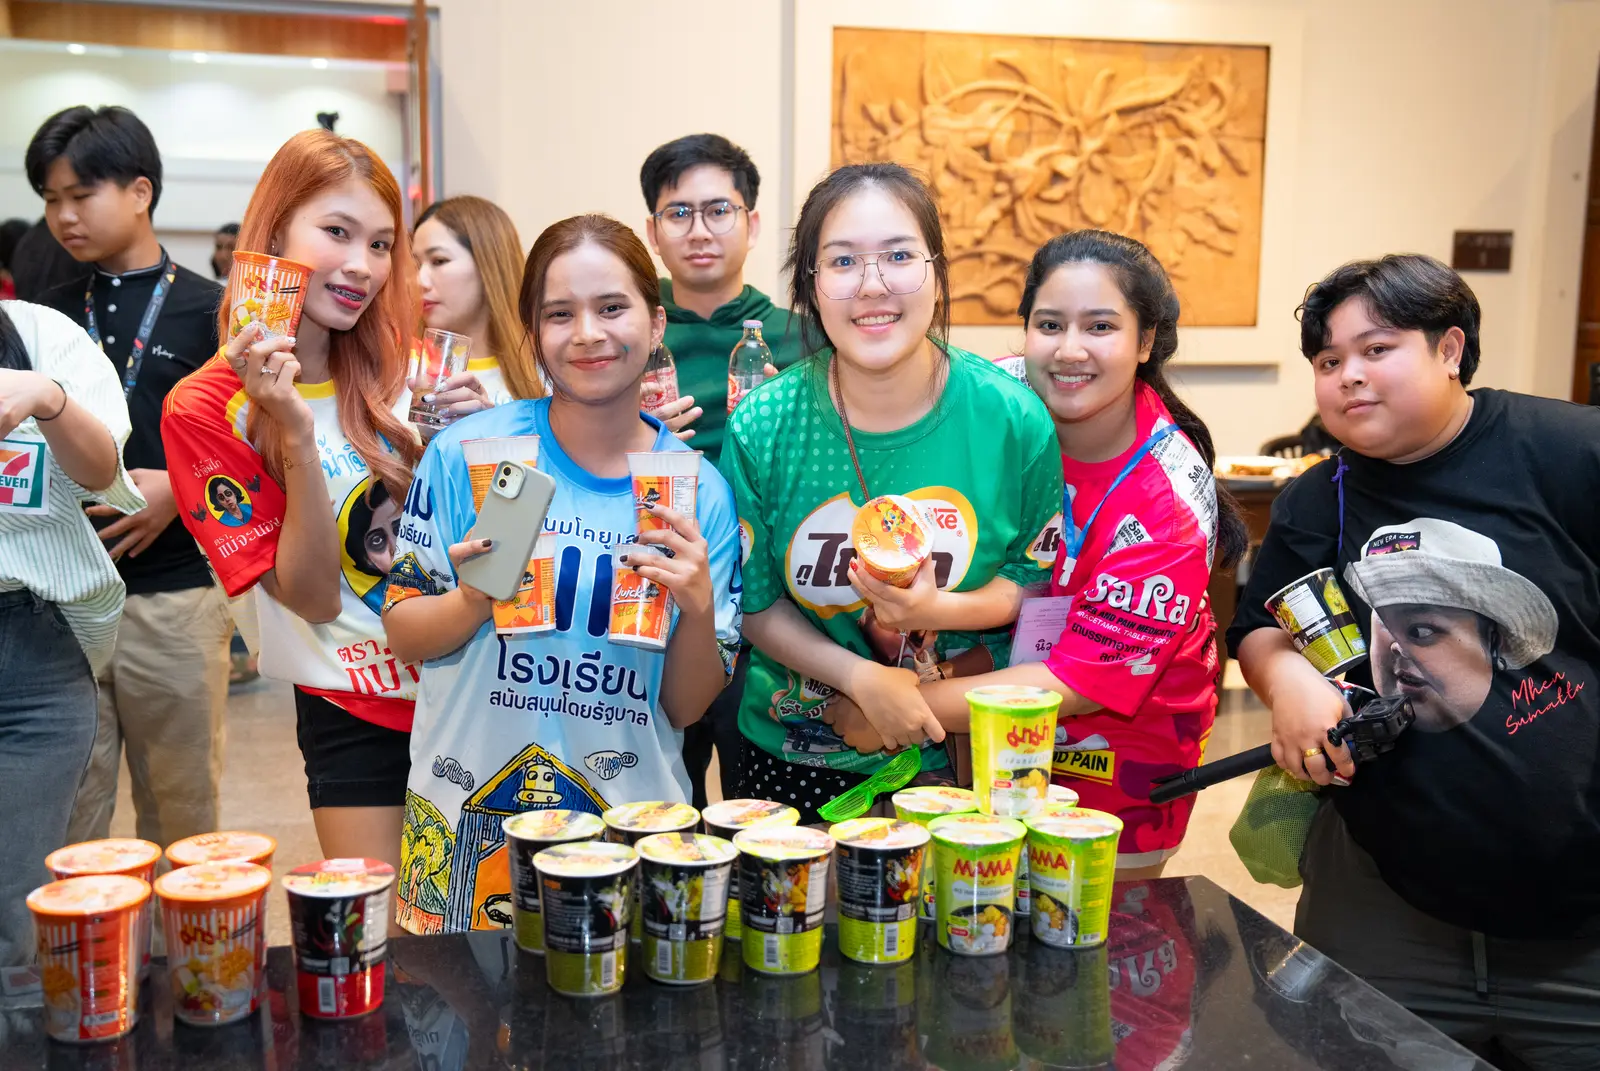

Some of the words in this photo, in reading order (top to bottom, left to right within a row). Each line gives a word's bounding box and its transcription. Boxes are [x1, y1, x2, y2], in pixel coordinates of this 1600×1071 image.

[933, 508, 958, 529] ke
[1372, 539, 1384, 548] NEW
[1385, 534, 1397, 543] ERA
[1098, 611, 1117, 622] AND
[1116, 617, 1137, 630] PAIN
[336, 639, 381, 663] ตรา
[497, 634, 648, 702] โรงเรียน
[489, 688, 649, 726] สนับสนุนโดยรัฐบาล
[1070, 751, 1108, 773] PAIN
[953, 858, 1013, 878] MAMA
[1031, 847, 1069, 871] AMA
